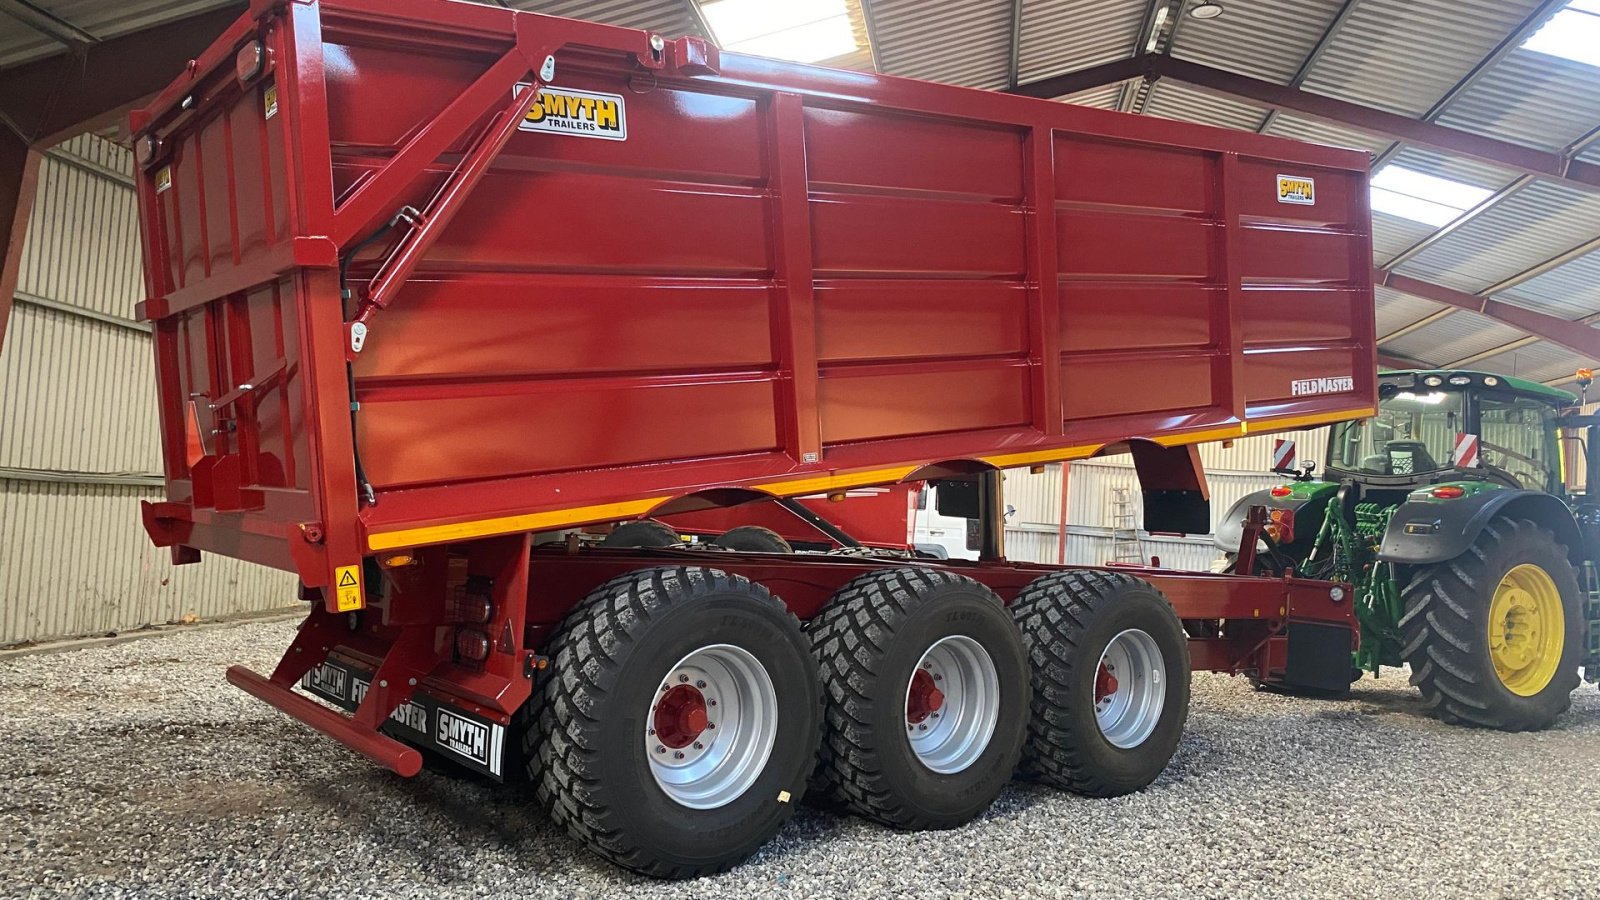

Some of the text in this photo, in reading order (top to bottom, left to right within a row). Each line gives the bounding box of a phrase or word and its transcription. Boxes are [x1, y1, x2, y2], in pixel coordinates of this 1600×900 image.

[548, 118, 595, 131] TRAILERS
[1280, 179, 1312, 199] SMYTH
[439, 713, 485, 758] SMYTH
[449, 738, 472, 756] TRAILERS
